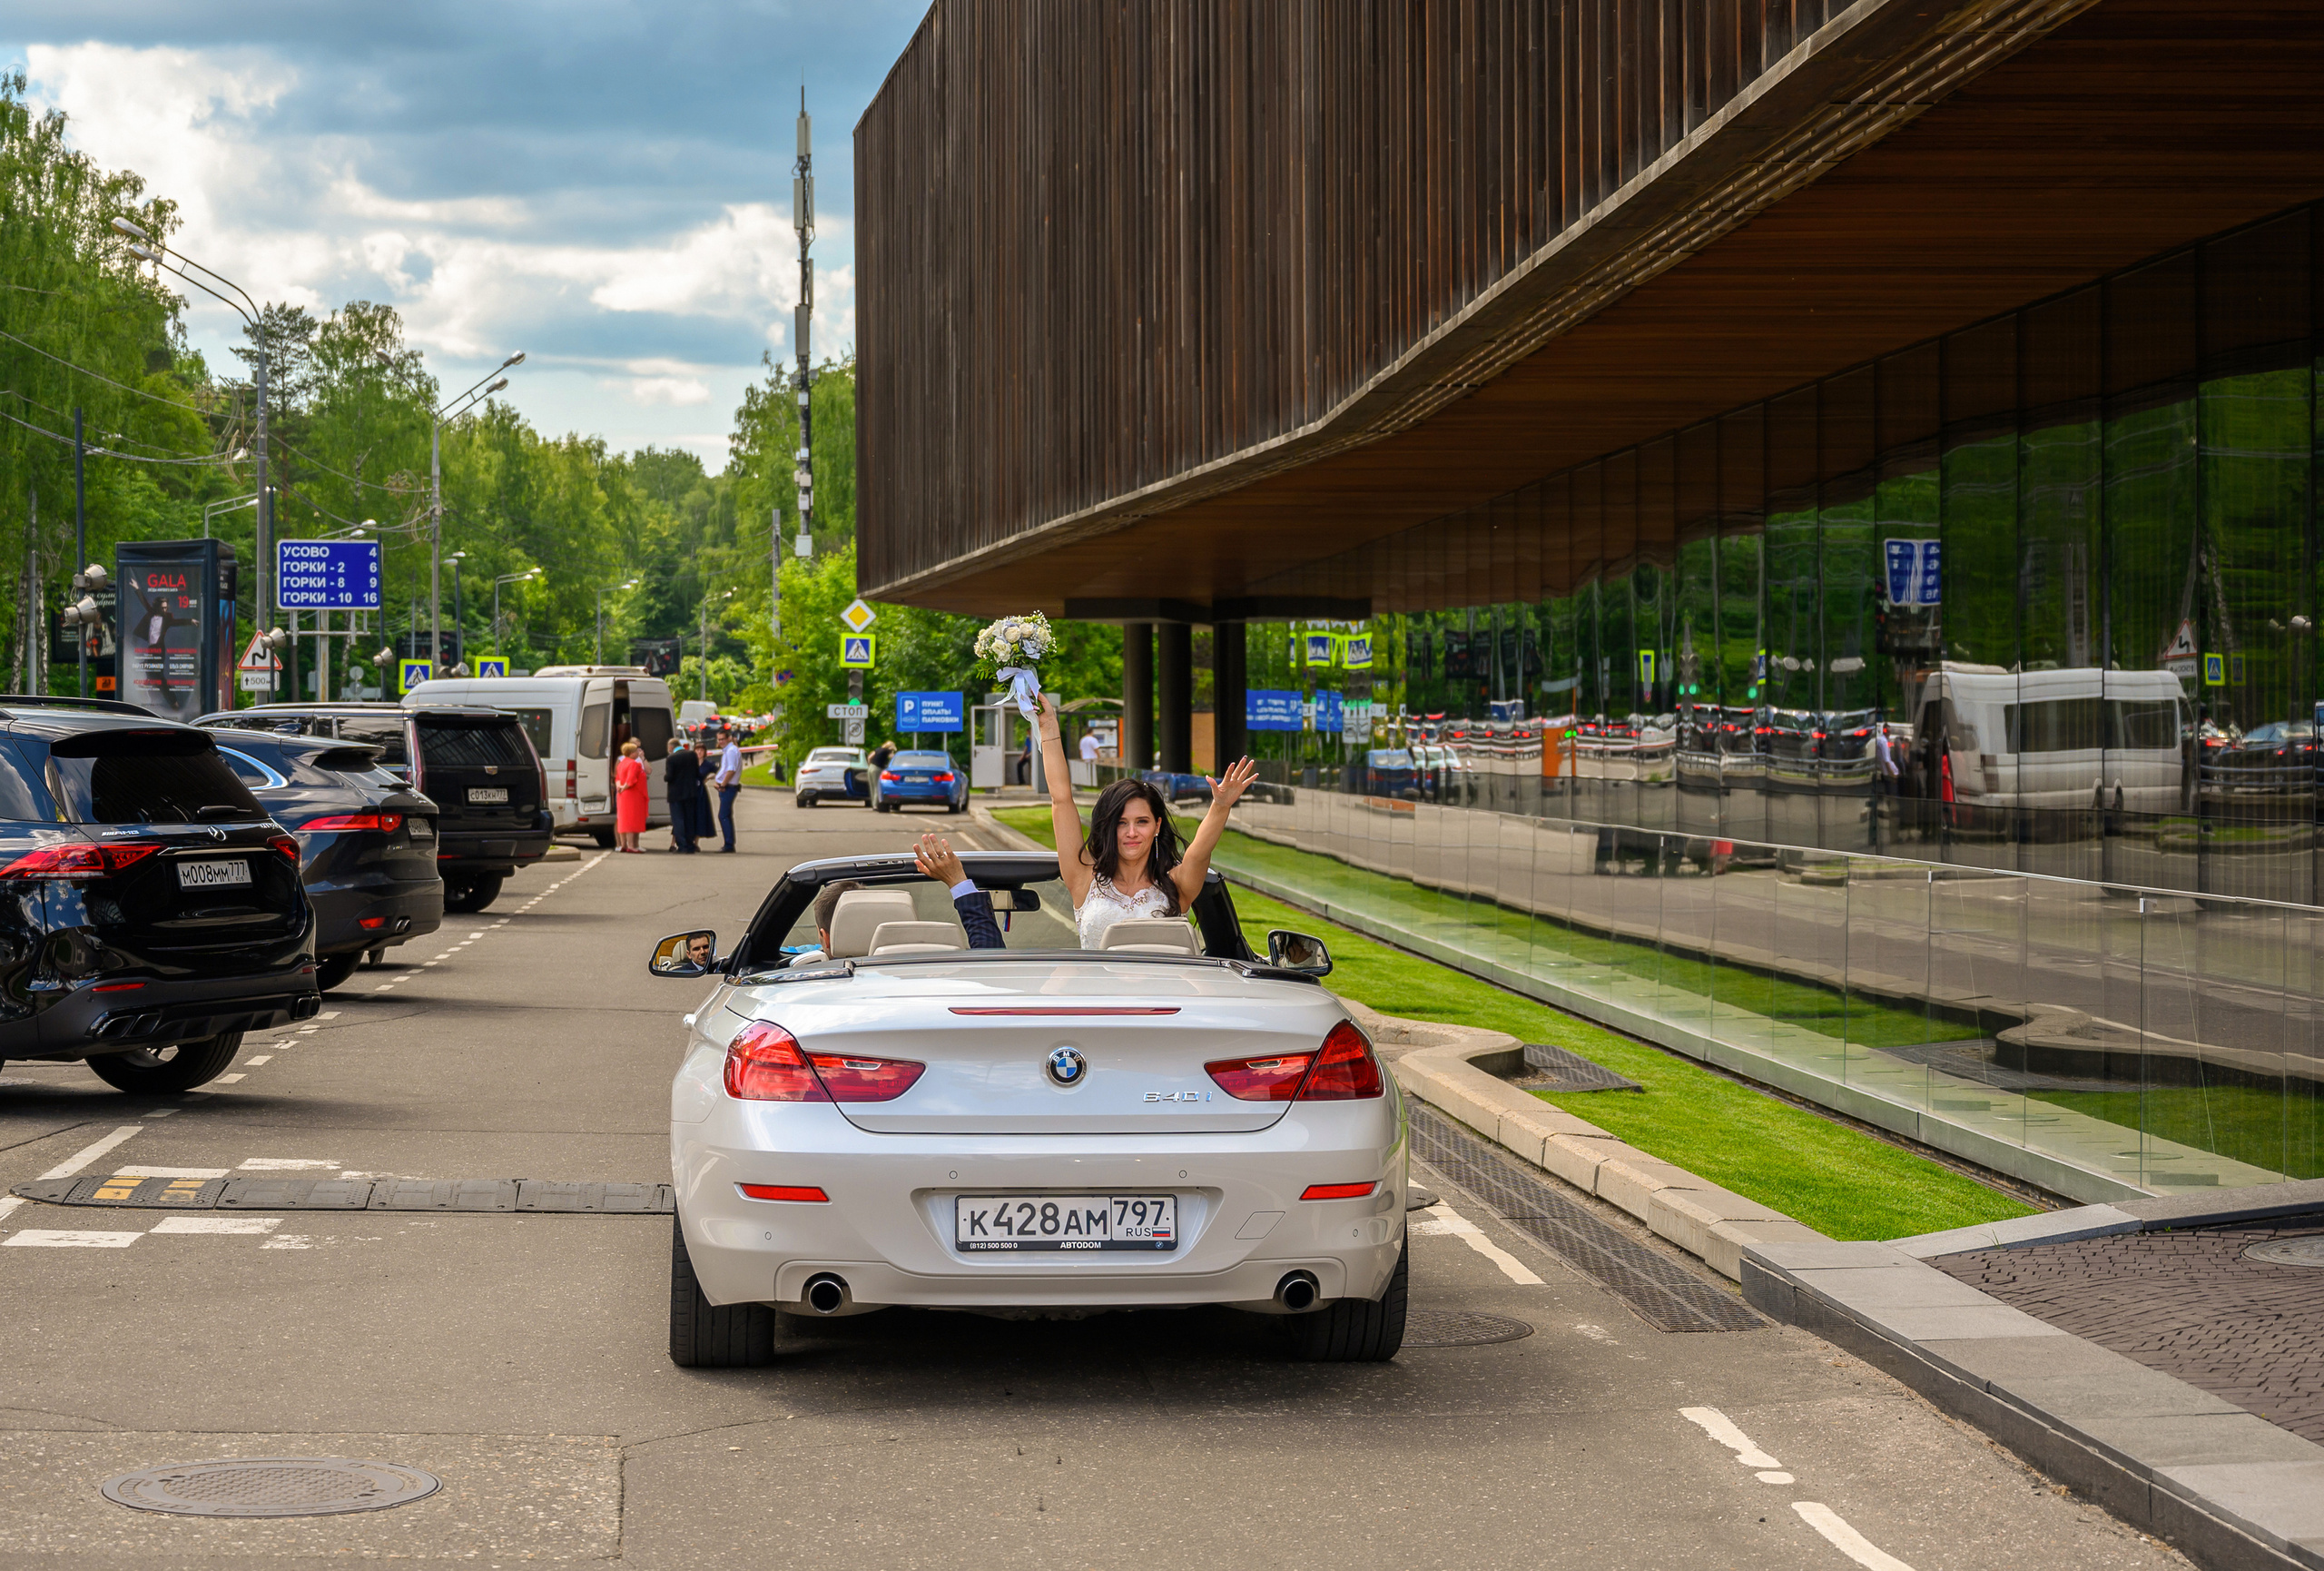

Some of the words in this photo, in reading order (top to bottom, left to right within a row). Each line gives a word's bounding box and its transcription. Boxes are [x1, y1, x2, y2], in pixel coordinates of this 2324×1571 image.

[283, 546, 330, 558] УСОВО
[369, 547, 377, 558] 4
[283, 562, 326, 573] ГОРКИ
[338, 562, 345, 573] 2
[369, 562, 377, 573] 6
[147, 573, 186, 587] GALA
[283, 577, 326, 588] ГОРКИ
[338, 577, 345, 588] 8
[369, 577, 377, 588] 9
[178, 596, 188, 608] 19
[283, 592, 326, 603] ГОРКИ
[338, 592, 352, 603] 10
[363, 592, 377, 603] 16
[834, 707, 862, 716] СТОП
[182, 865, 230, 885] М008ММ
[229, 862, 245, 876] 777
[1053, 1050, 1081, 1062] BMW
[970, 1202, 1107, 1236] К428АМ
[1113, 1200, 1165, 1226] 797
[1126, 1228, 1151, 1237] RUS
